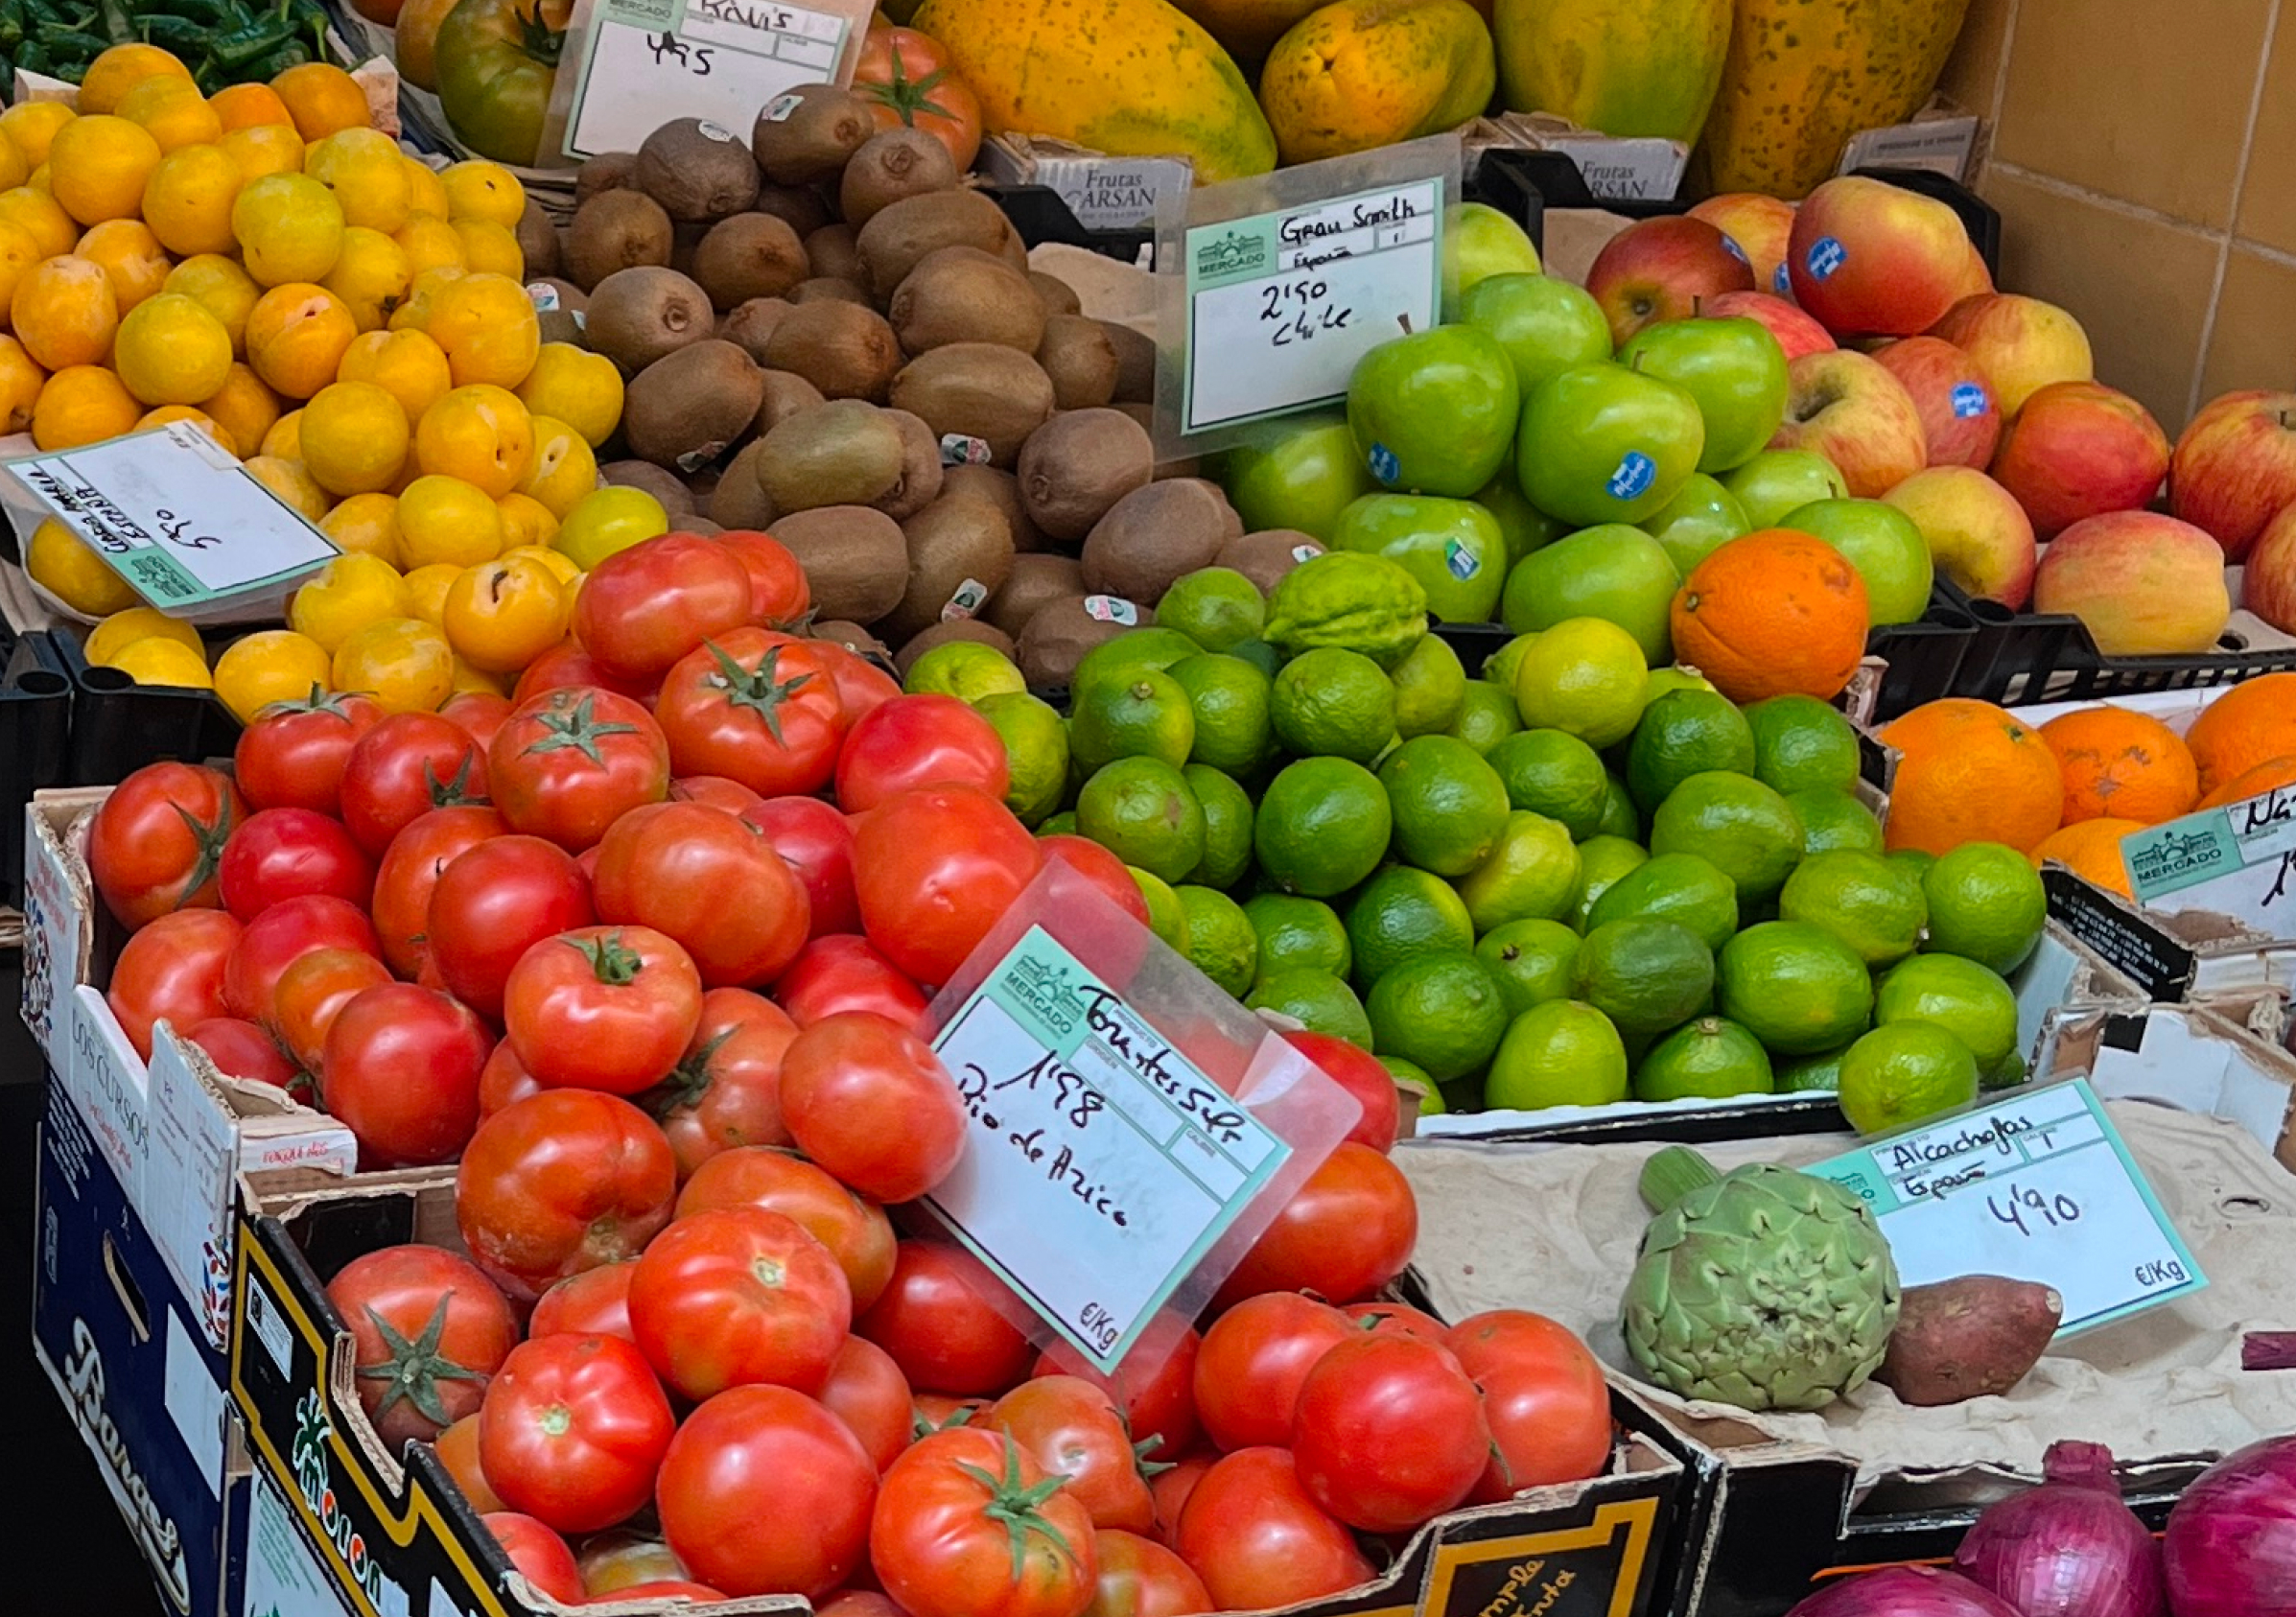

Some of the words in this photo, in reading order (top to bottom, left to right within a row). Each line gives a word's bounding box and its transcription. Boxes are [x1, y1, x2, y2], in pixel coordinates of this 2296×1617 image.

[1087, 170, 1142, 188] Frutas
[1583, 160, 1636, 179] Frutas
[1353, 197, 1416, 227] Smith
[1199, 252, 1265, 274] MERCADO
[1260, 281, 1327, 320] 2'90
[146, 555, 195, 595] MERCADO
[2137, 849, 2222, 881] MERCADO
[1005, 972, 1072, 1034] MERCADO
[73, 1008, 94, 1068] LOS
[97, 1055, 149, 1160] CURSOS
[1010, 1129, 1044, 1162] de
[1893, 1116, 2033, 1168] Alcachofas
[1986, 1183, 2080, 1236] 4'90
[2135, 1259, 2185, 1286] €/Kg
[1079, 1301, 1118, 1351] €/Kg
